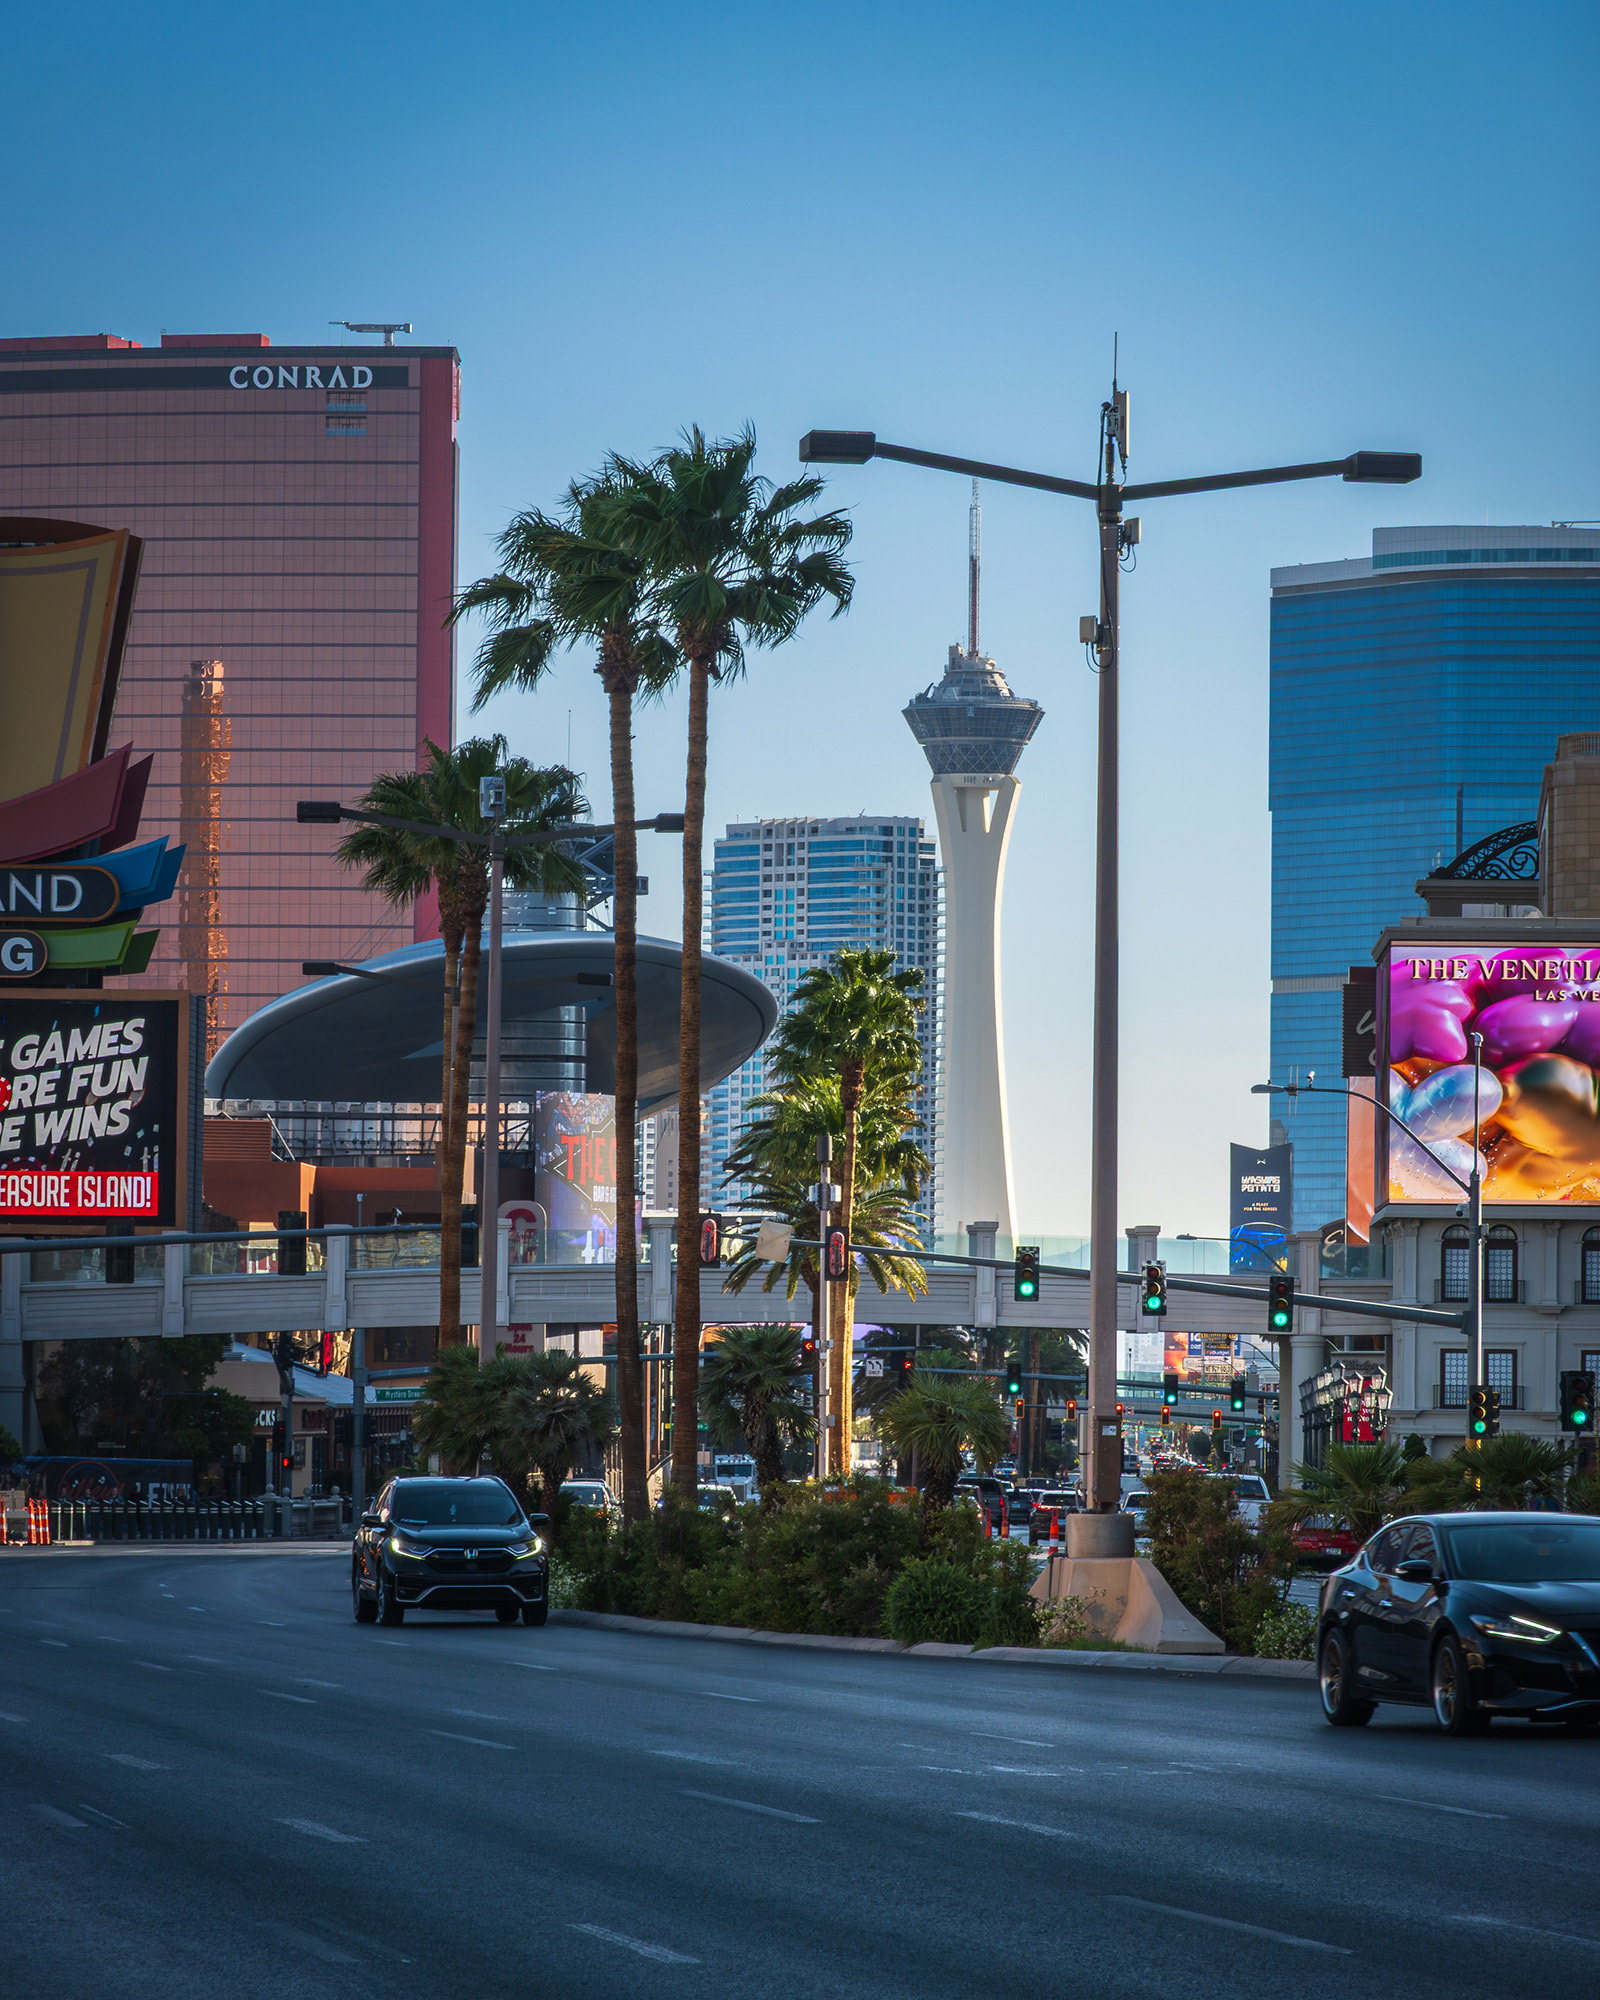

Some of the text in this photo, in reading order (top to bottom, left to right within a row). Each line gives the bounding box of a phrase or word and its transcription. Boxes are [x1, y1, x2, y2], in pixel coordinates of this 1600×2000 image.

[229, 365, 373, 389] CONRAD
[0, 872, 83, 913] ND
[1408, 958, 1469, 981] THE
[1535, 989, 1567, 1001] LAS
[11, 1018, 145, 1070] GAMES
[67, 1056, 149, 1102] FUN
[34, 1100, 132, 1147] WINS
[561, 1134, 606, 1186] THE
[78, 1176, 152, 1208] ISLAND!
[1241, 1175, 1280, 1184] WASHING
[1241, 1184, 1280, 1193] POTATO
[512, 1333, 527, 1344] 24
